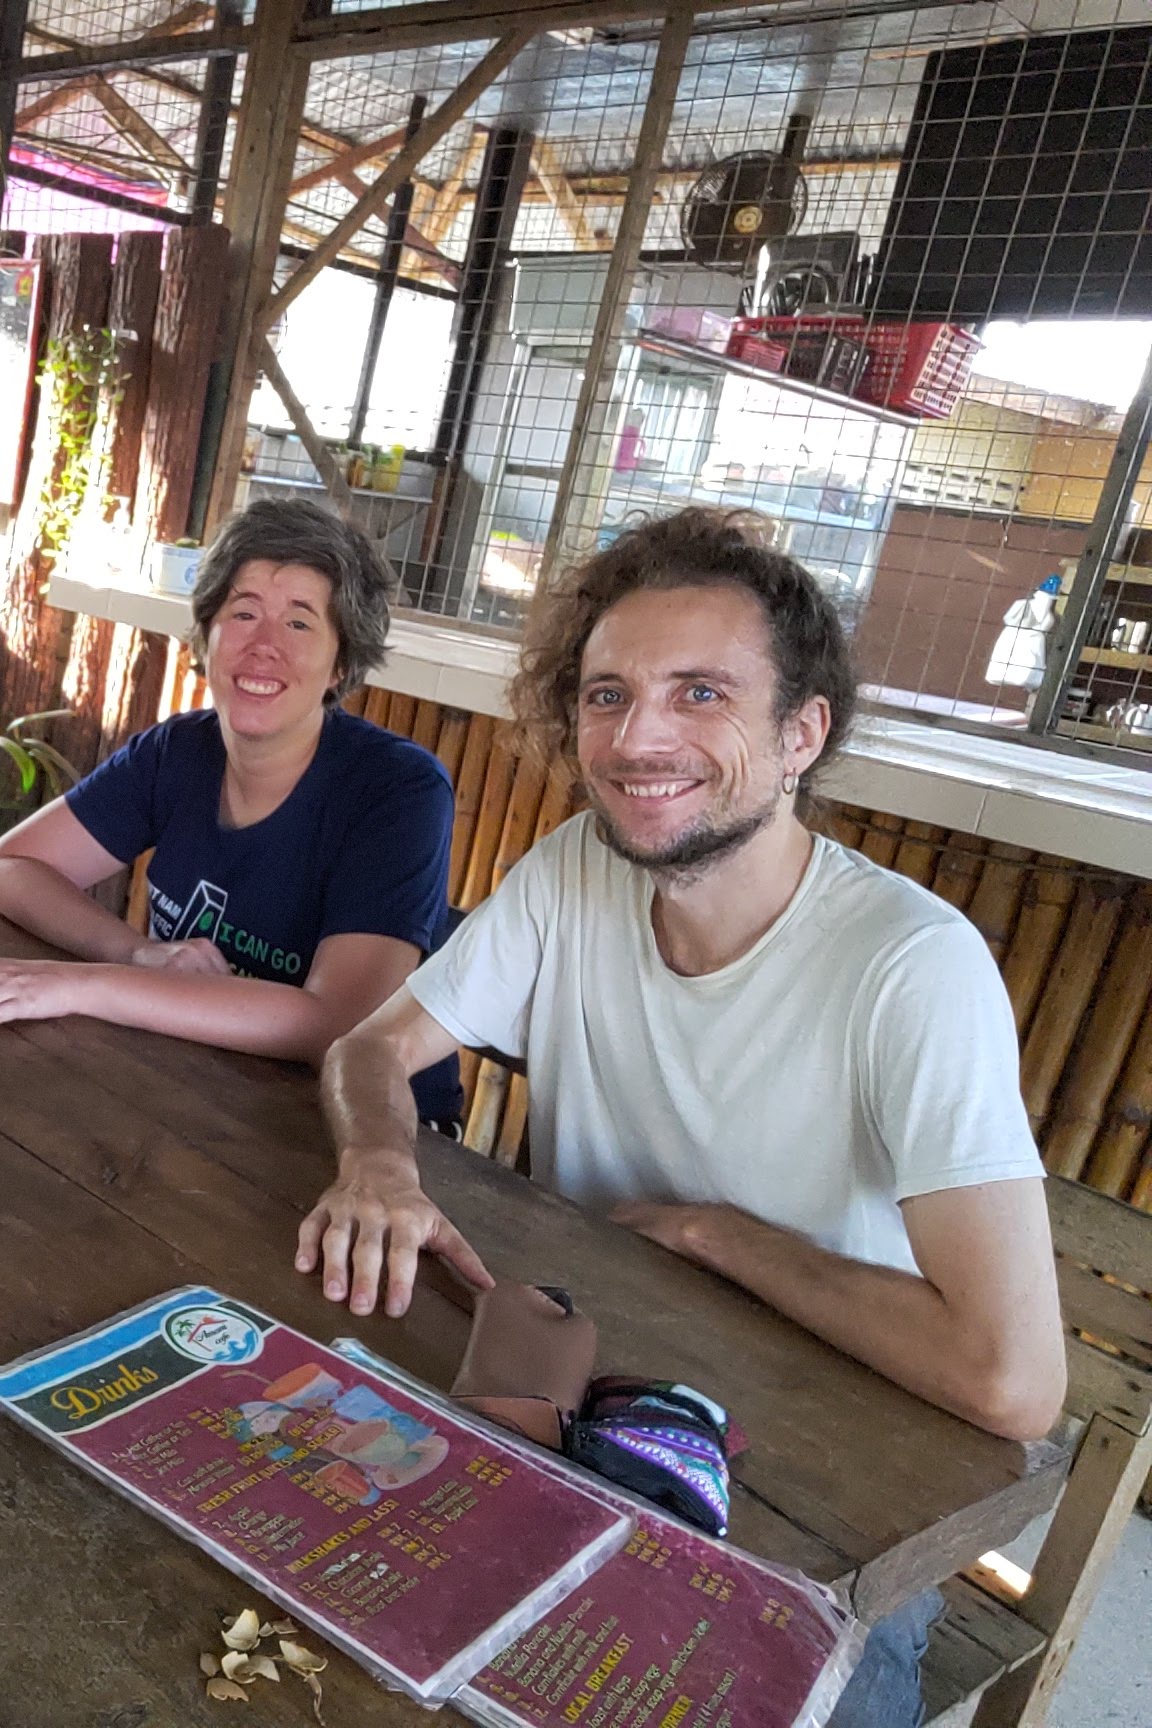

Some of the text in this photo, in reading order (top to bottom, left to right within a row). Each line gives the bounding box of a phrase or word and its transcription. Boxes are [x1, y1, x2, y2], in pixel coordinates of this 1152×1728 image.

[235, 929, 269, 963] CAN
[271, 948, 301, 975] GO
[50, 1364, 158, 1419] Drinks
[196, 1490, 234, 1513] FRESH
[229, 1473, 262, 1494] FRUIT
[284, 1531, 350, 1574] MILKSHAKES
[348, 1518, 372, 1535] AND
[366, 1499, 399, 1521] LASSI
[716, 1586, 732, 1601] RM
[502, 1652, 529, 1677] Nutella
[522, 1624, 552, 1655] Pancake
[516, 1658, 545, 1687] Banana
[560, 1633, 633, 1724] LOCAL BREAKFAST
[631, 1680, 650, 1699] soup
[585, 1707, 608, 1728] Toast
[603, 1691, 620, 1709] with
[647, 1689, 665, 1709] soup
[659, 1695, 693, 1728] ORNER
